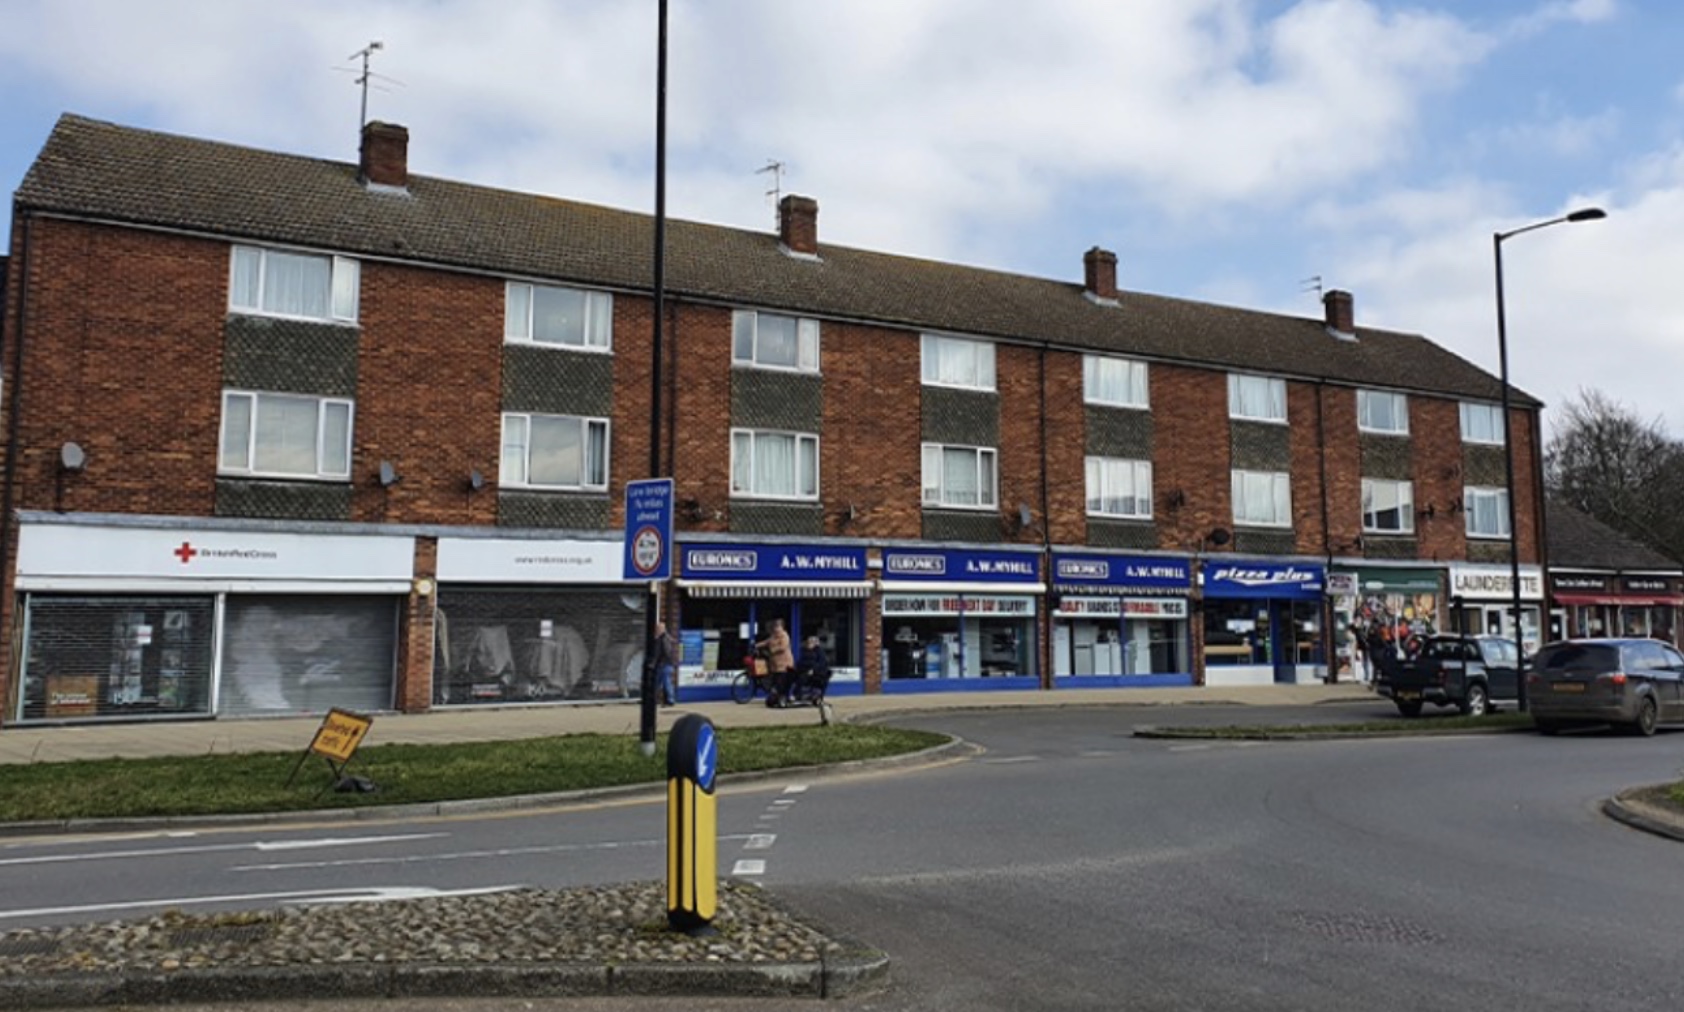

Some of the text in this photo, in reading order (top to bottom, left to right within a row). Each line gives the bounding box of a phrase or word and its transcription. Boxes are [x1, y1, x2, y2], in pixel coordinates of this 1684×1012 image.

[691, 551, 752, 568] EURONICS
[889, 556, 942, 571] EURONICS
[1213, 566, 1315, 582] pizza plus
